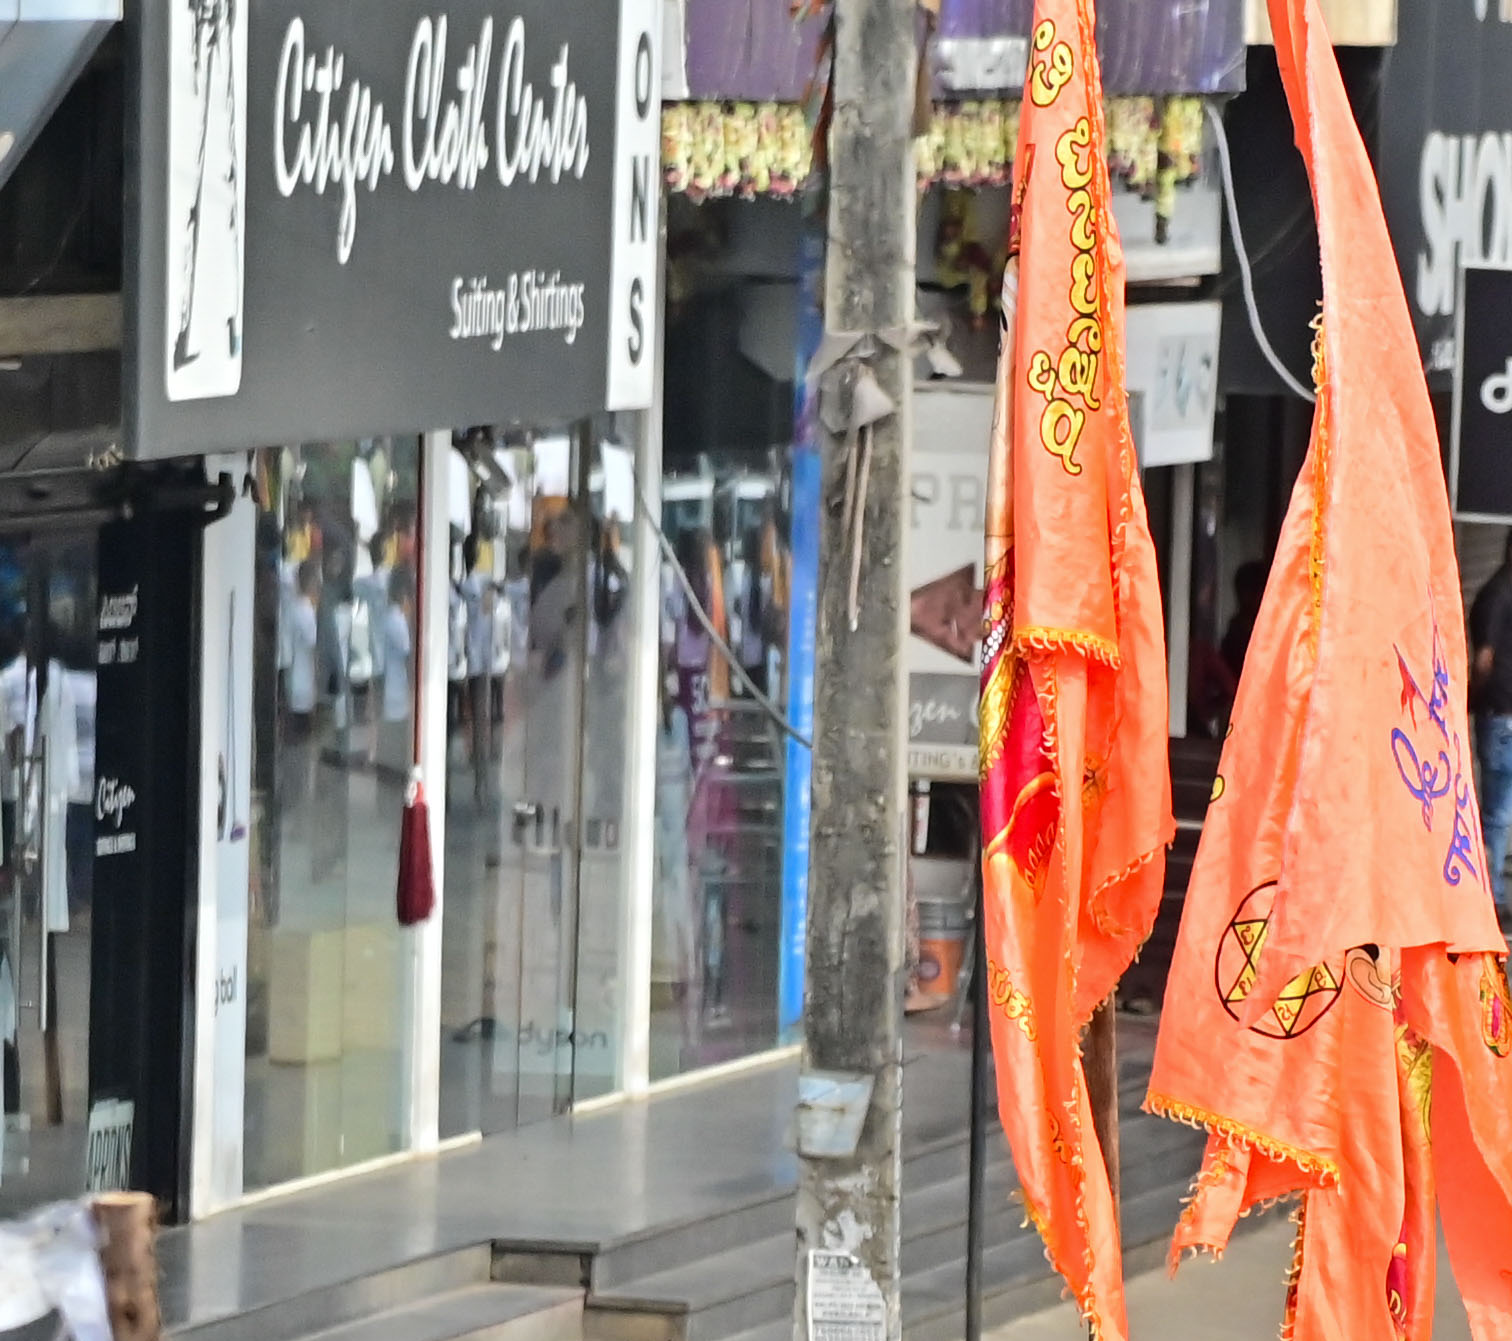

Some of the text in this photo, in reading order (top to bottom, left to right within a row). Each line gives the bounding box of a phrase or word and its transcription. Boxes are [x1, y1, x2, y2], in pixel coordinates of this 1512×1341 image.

[273, 15, 395, 265] Citizen
[402, 15, 489, 191] Cloth
[506, 272, 520, 333] &
